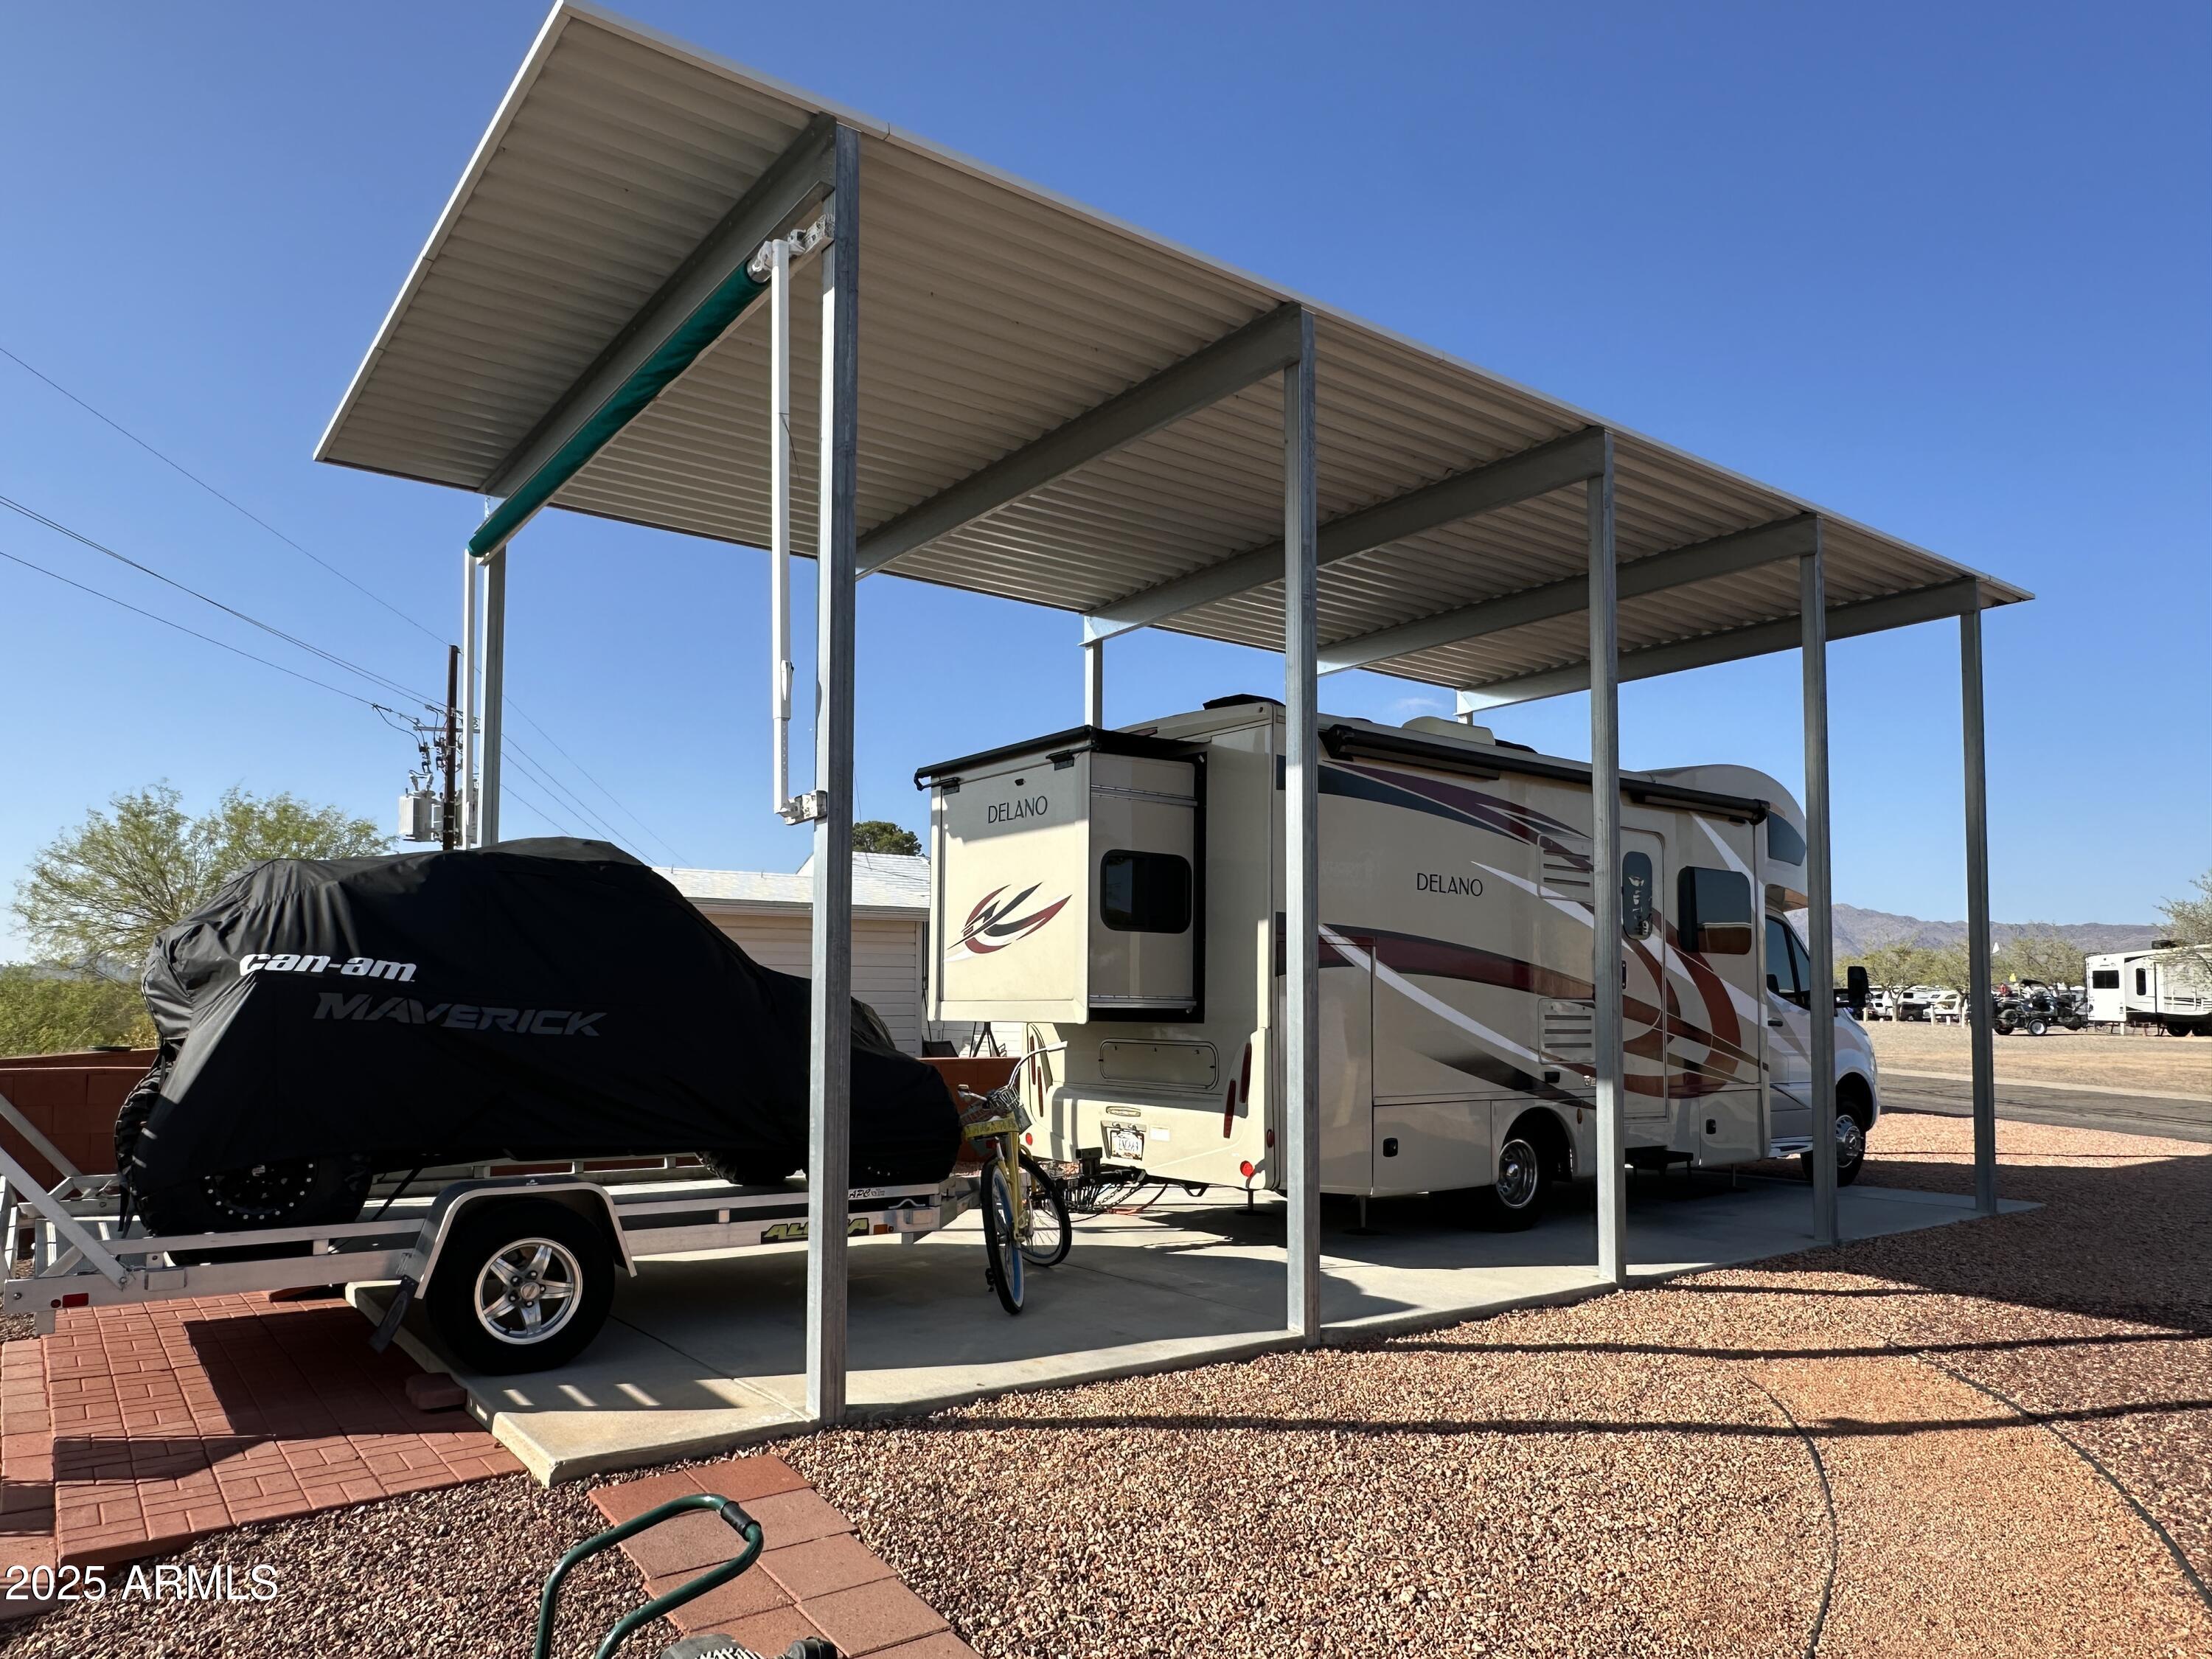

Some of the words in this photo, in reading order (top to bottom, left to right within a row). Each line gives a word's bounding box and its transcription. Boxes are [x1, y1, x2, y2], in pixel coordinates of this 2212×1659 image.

[988, 796, 1048, 824] DELANO
[1416, 872, 1484, 897] DELANO
[240, 953, 417, 982] can-am
[313, 992, 608, 1036] MAVERICK
[762, 1218, 869, 1240] ALA
